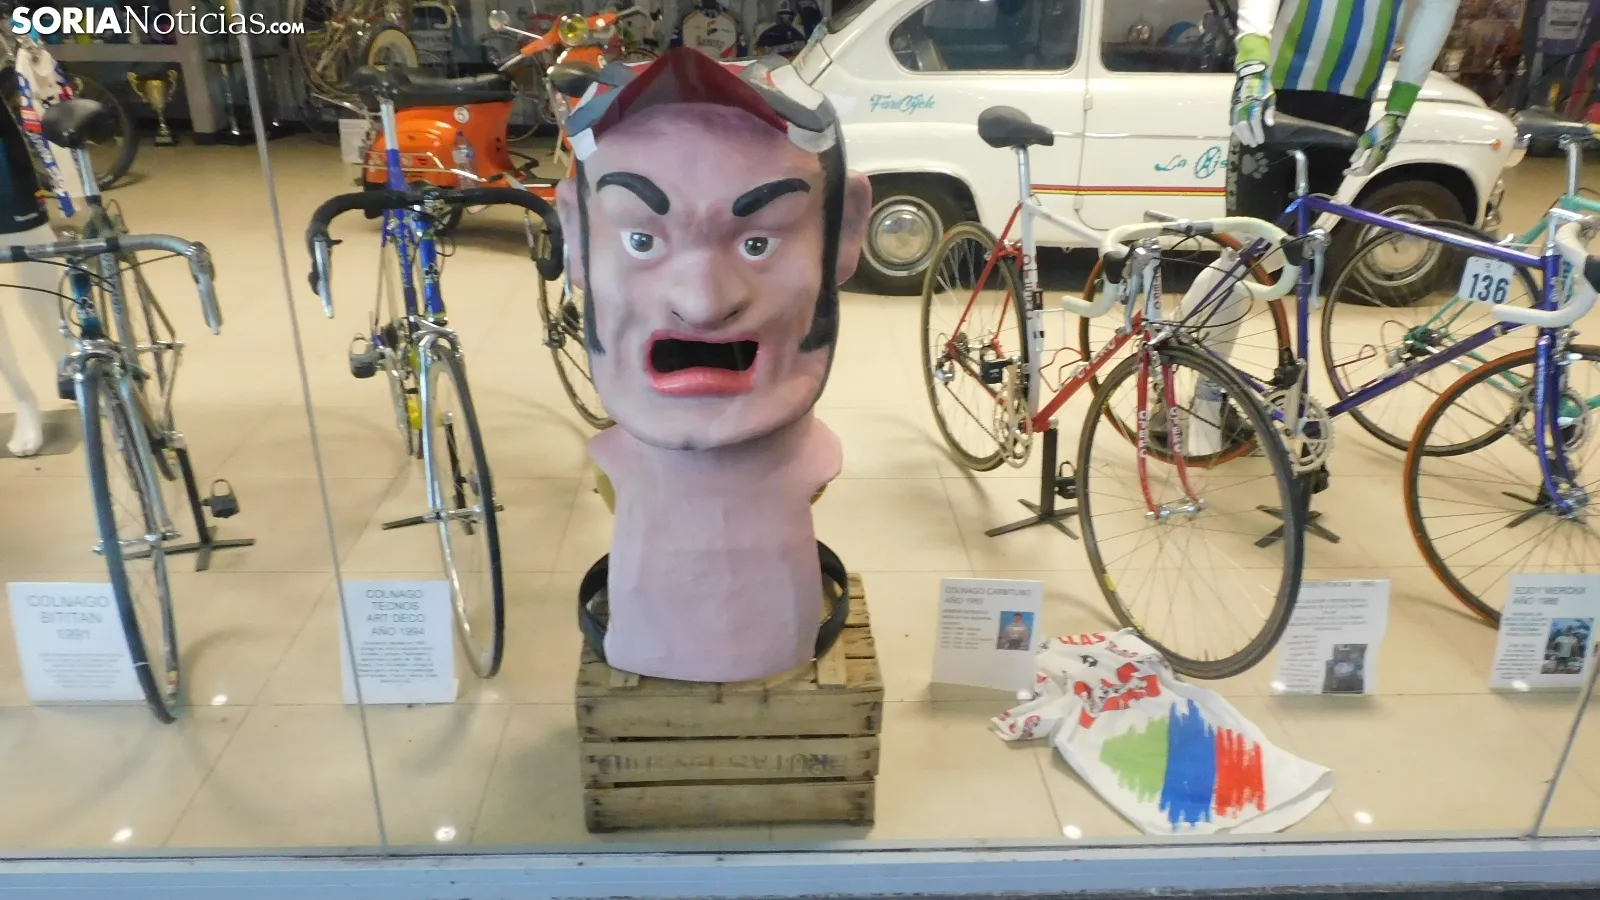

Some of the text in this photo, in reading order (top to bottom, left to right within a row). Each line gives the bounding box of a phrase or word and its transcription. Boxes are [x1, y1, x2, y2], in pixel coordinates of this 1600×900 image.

[1468, 273, 1509, 305] 136
[366, 589, 424, 598] COLNAGO
[26, 595, 110, 607] COLNAGO
[371, 601, 420, 610] TECNOS
[366, 613, 425, 622] ART DECO
[371, 625, 396, 635] AÑO
